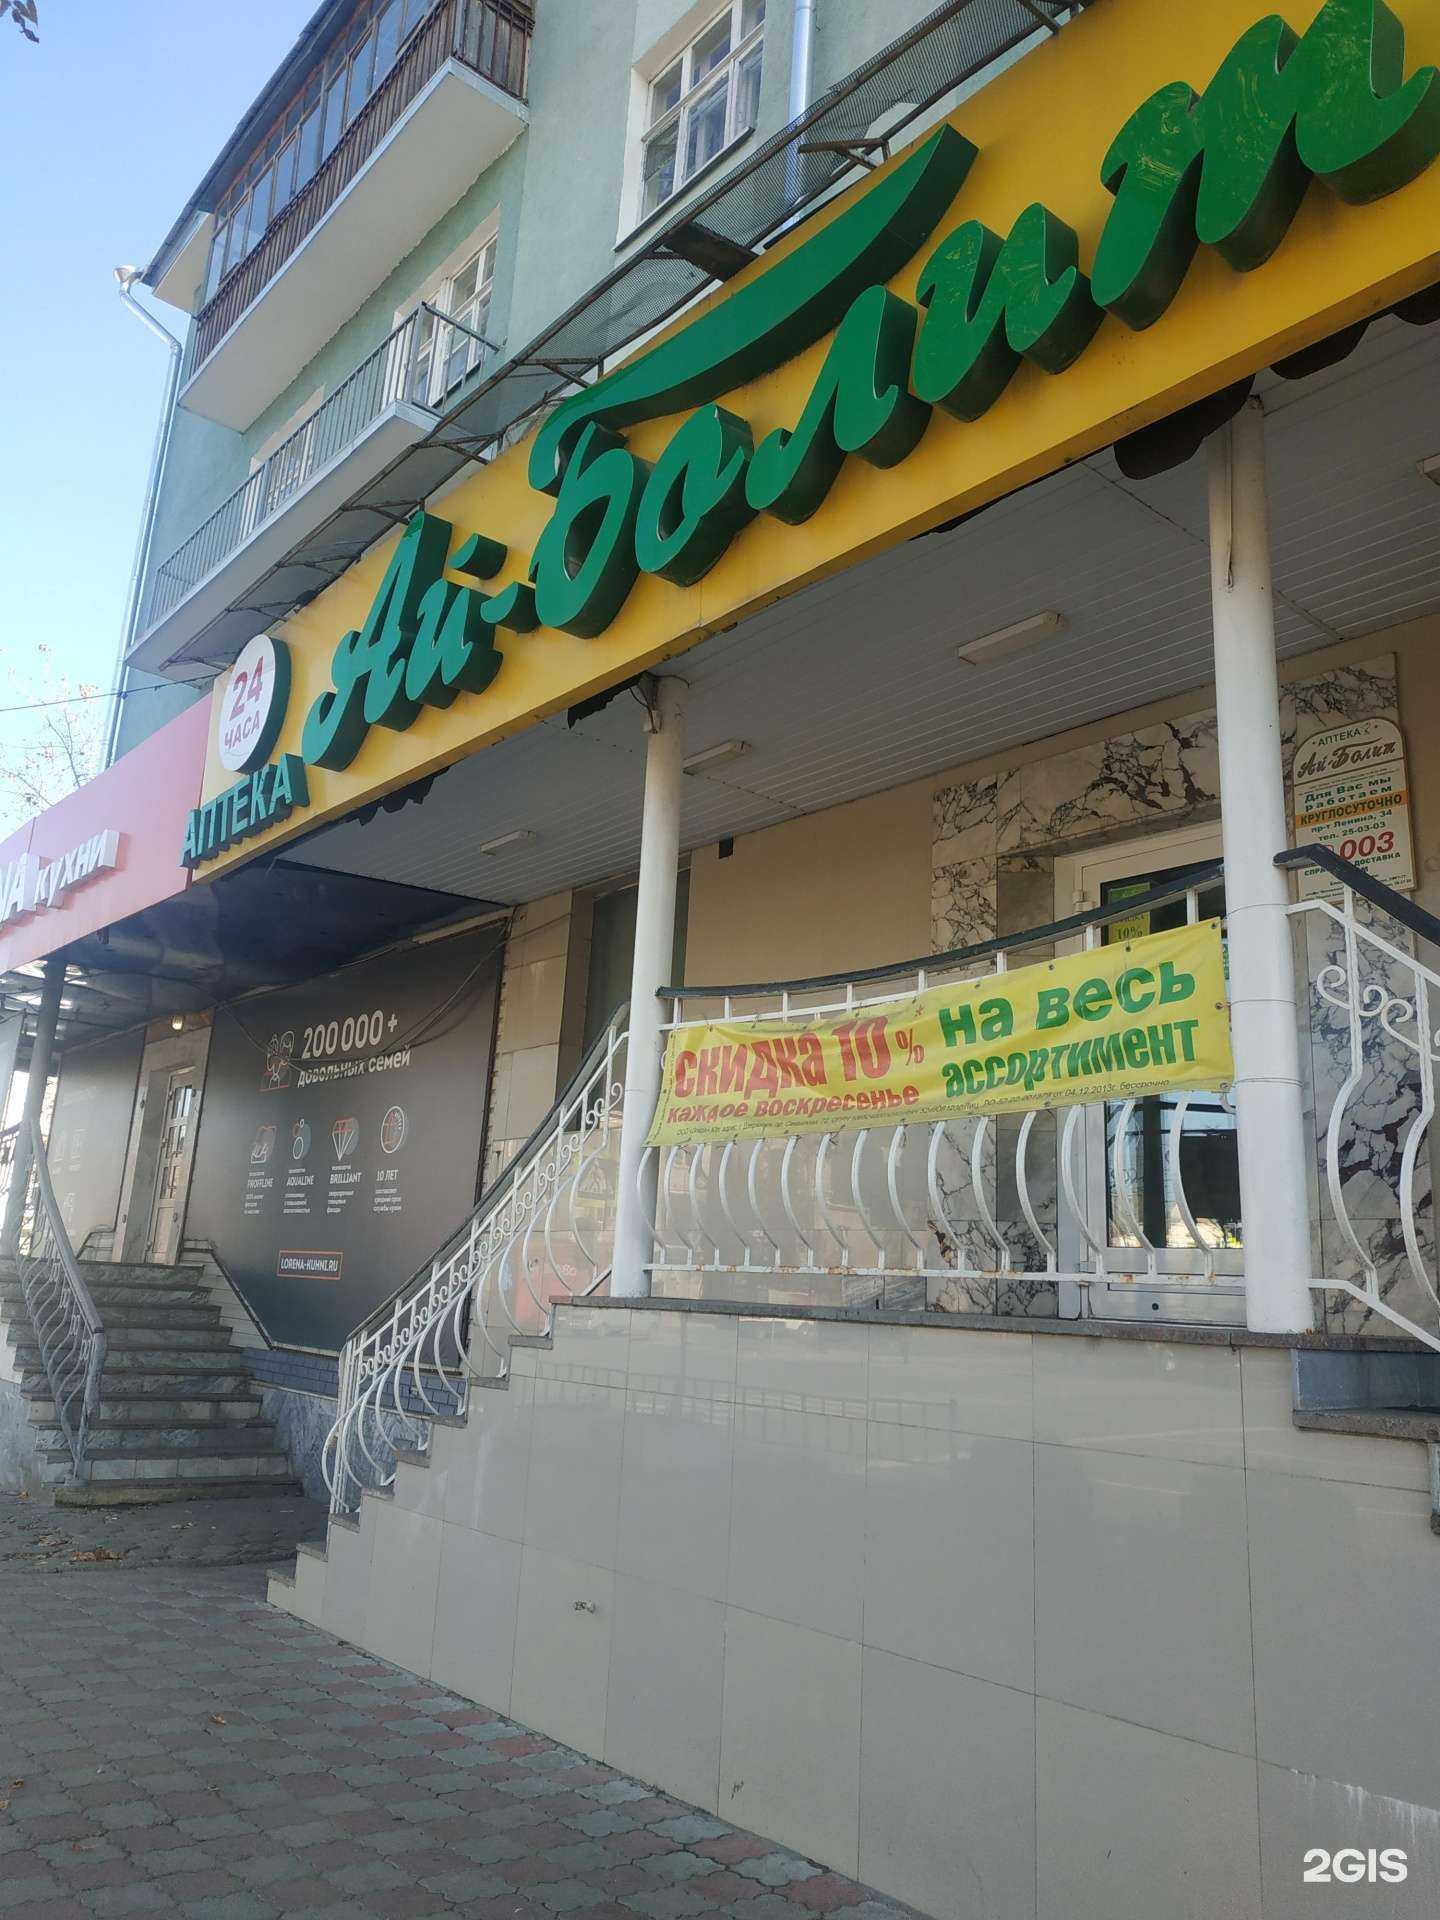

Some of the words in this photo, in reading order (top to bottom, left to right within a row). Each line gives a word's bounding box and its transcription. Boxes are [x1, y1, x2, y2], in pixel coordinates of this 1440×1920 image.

[229, 655, 264, 721] 24
[224, 710, 260, 749] ЧАСА
[1318, 728, 1361, 746] АПТЕКА
[1304, 791, 1332, 803] Для
[1336, 783, 1363, 794] Вас
[1369, 777, 1391, 787] мы
[1305, 786, 1392, 812] работаем
[180, 752, 293, 868] АПТЕКА
[1300, 794, 1402, 826] КРУГЛОСУТОЧНО
[1318, 833, 1339, 842] тел.
[1342, 821, 1386, 837] 25-03-03
[369, 1046, 412, 1072] семей
[667, 1103, 748, 1124] каждое
[754, 1085, 920, 1117] воскресенье
[385, 1169, 399, 1181] ЛЕТ
[280, 1258, 338, 1272] LORENA-KUHNI.RU
